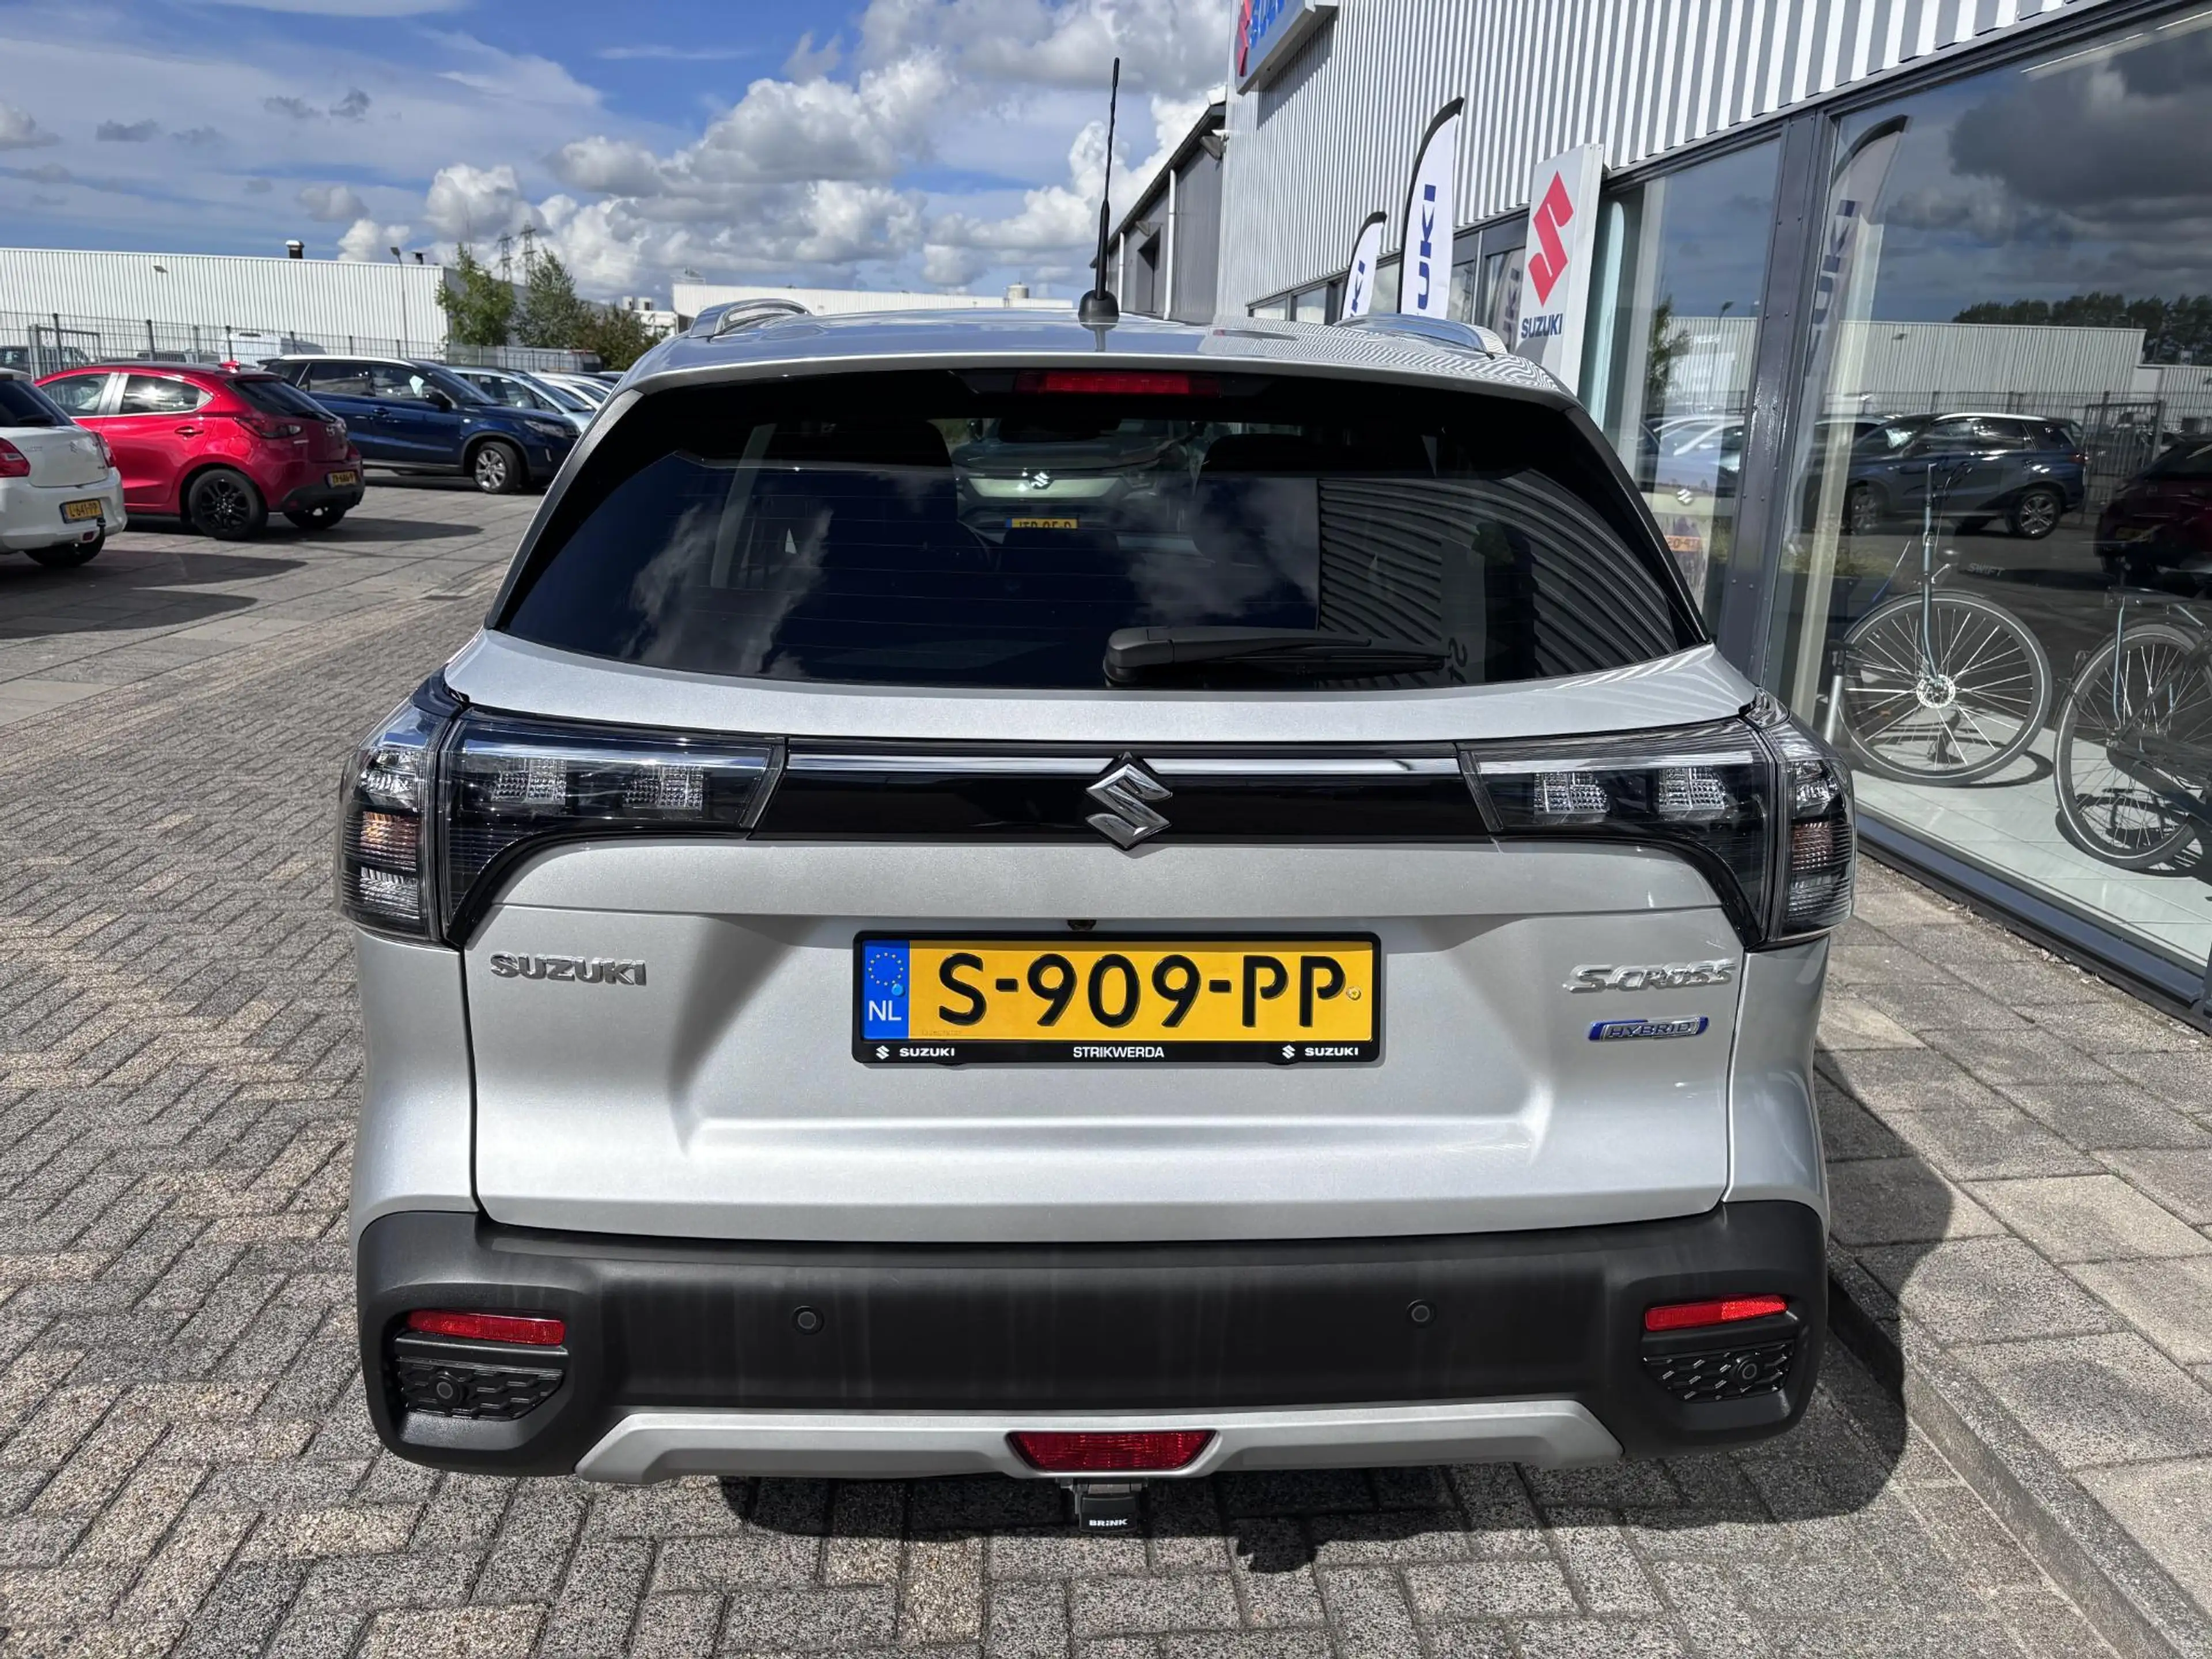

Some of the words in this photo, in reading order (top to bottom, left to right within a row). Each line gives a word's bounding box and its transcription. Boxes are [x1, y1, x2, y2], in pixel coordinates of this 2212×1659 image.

[1418, 184, 1436, 316] UKI
[1350, 260, 1365, 316] KI
[1521, 313, 1563, 339] SUZUKI
[490, 951, 646, 986] SUZUKI
[938, 953, 1346, 1028] S-909-PP
[869, 1000, 902, 1021] NL
[1609, 1022, 1691, 1037] HYBRID
[899, 1047, 955, 1057] SUZUKI
[1073, 1046, 1165, 1058] STRIKWERDA
[1304, 1047, 1359, 1056] SUZUKI
